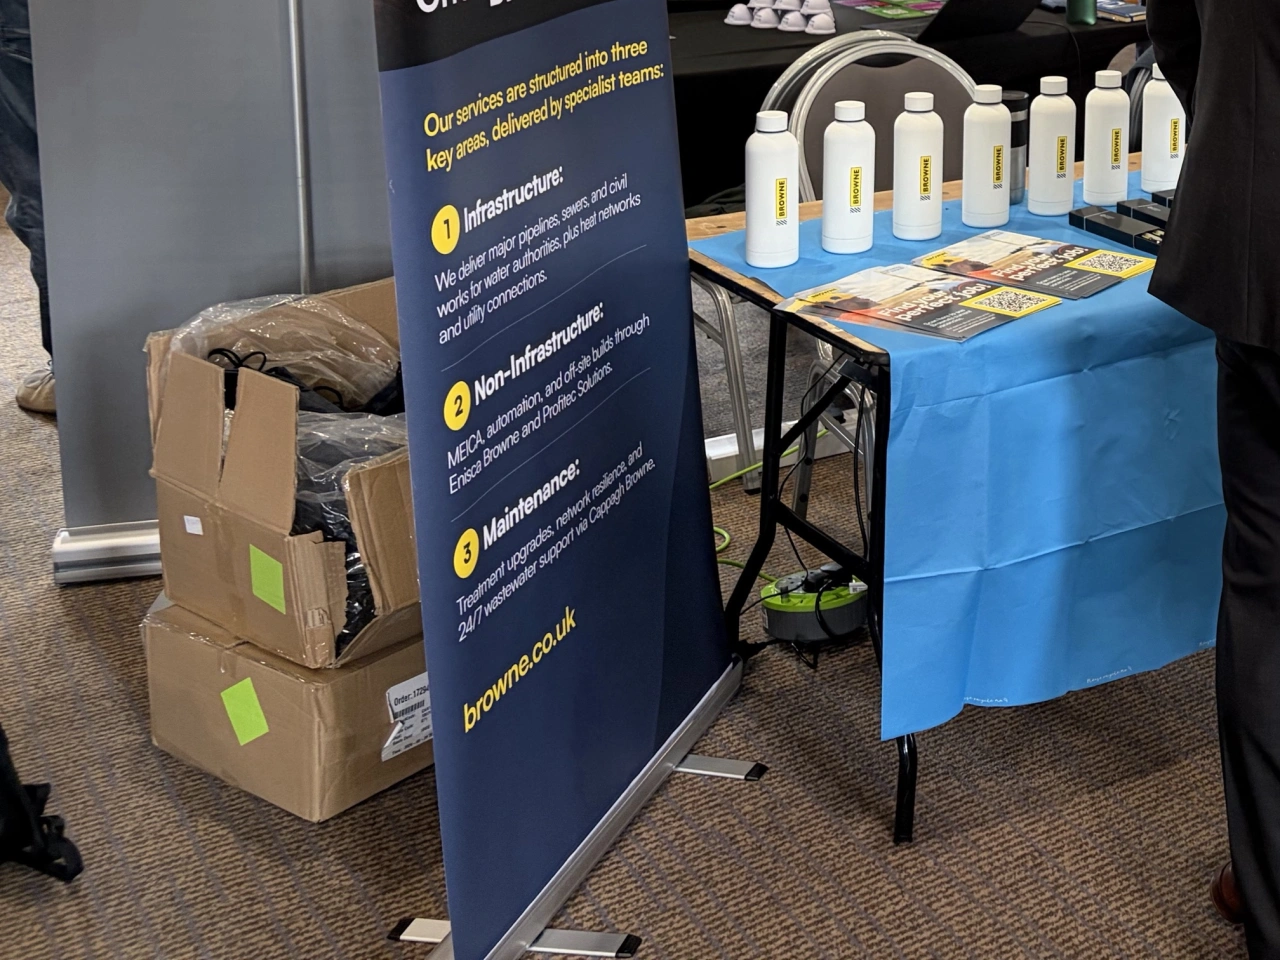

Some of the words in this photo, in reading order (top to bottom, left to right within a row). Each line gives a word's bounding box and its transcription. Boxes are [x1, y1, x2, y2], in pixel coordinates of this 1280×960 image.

[424, 112, 454, 137] Our
[455, 92, 504, 126] services
[506, 83, 527, 104] are
[529, 53, 583, 94] structured
[585, 50, 608, 72] into
[610, 40, 648, 62] three
[426, 147, 453, 172] key
[456, 131, 490, 160] areas,
[492, 98, 548, 142] delivered
[550, 95, 563, 121] by
[564, 73, 616, 113] specialist
[618, 63, 664, 87] teams:
[434, 270, 457, 292] We
[458, 251, 487, 281] deliver
[488, 236, 516, 262] major
[518, 214, 561, 250] pipelines,
[561, 197, 590, 224] sewers,
[590, 182, 608, 204] and
[609, 172, 628, 195] civil
[443, 218, 451, 240] 1
[464, 165, 564, 234] Infrastructure:
[778, 180, 786, 217] BROWNE
[852, 169, 860, 205] BROWNE
[436, 288, 470, 319] works
[470, 280, 483, 301] for
[483, 266, 510, 290] water
[512, 237, 562, 274] authorities,
[563, 222, 580, 249] plus
[580, 211, 597, 235] heat
[598, 192, 641, 224] networks
[879, 301, 917, 317] Find
[912, 290, 947, 305] your
[894, 294, 961, 322] perfect
[952, 283, 992, 299] job!
[990, 263, 1022, 277] Find
[1022, 253, 1051, 267] your
[1008, 255, 1064, 281] perfect
[1055, 246, 1089, 261] job!
[438, 316, 462, 345] and
[463, 300, 486, 324] utility
[487, 268, 548, 314] connections.
[447, 429, 486, 470] MEICA,
[486, 392, 544, 439] automation,
[545, 374, 563, 397] and
[564, 354, 592, 384] off-site
[592, 336, 614, 363] builds
[614, 313, 650, 345] through
[453, 394, 464, 417] 2
[474, 301, 604, 406] Non-Infrastructure:
[449, 457, 482, 495] Enisca
[483, 429, 520, 468] Browne
[521, 414, 541, 438] and
[543, 389, 577, 424] Profitec
[577, 361, 613, 397] Solutions.
[456, 563, 505, 616] Treatment
[507, 524, 555, 572] upgrades,
[555, 490, 591, 533] network
[591, 462, 628, 499] resilience,
[628, 441, 643, 467] and
[458, 605, 482, 642] 24/7
[484, 560, 538, 617] wastewater
[539, 530, 575, 568] support
[575, 513, 588, 536] via
[589, 484, 625, 525] Cappagh
[625, 458, 656, 495] Browne.
[463, 541, 472, 564] 3
[482, 458, 581, 550] Maintenance:
[393, 692, 413, 706] Order:
[463, 606, 577, 733] browne.co.uk
